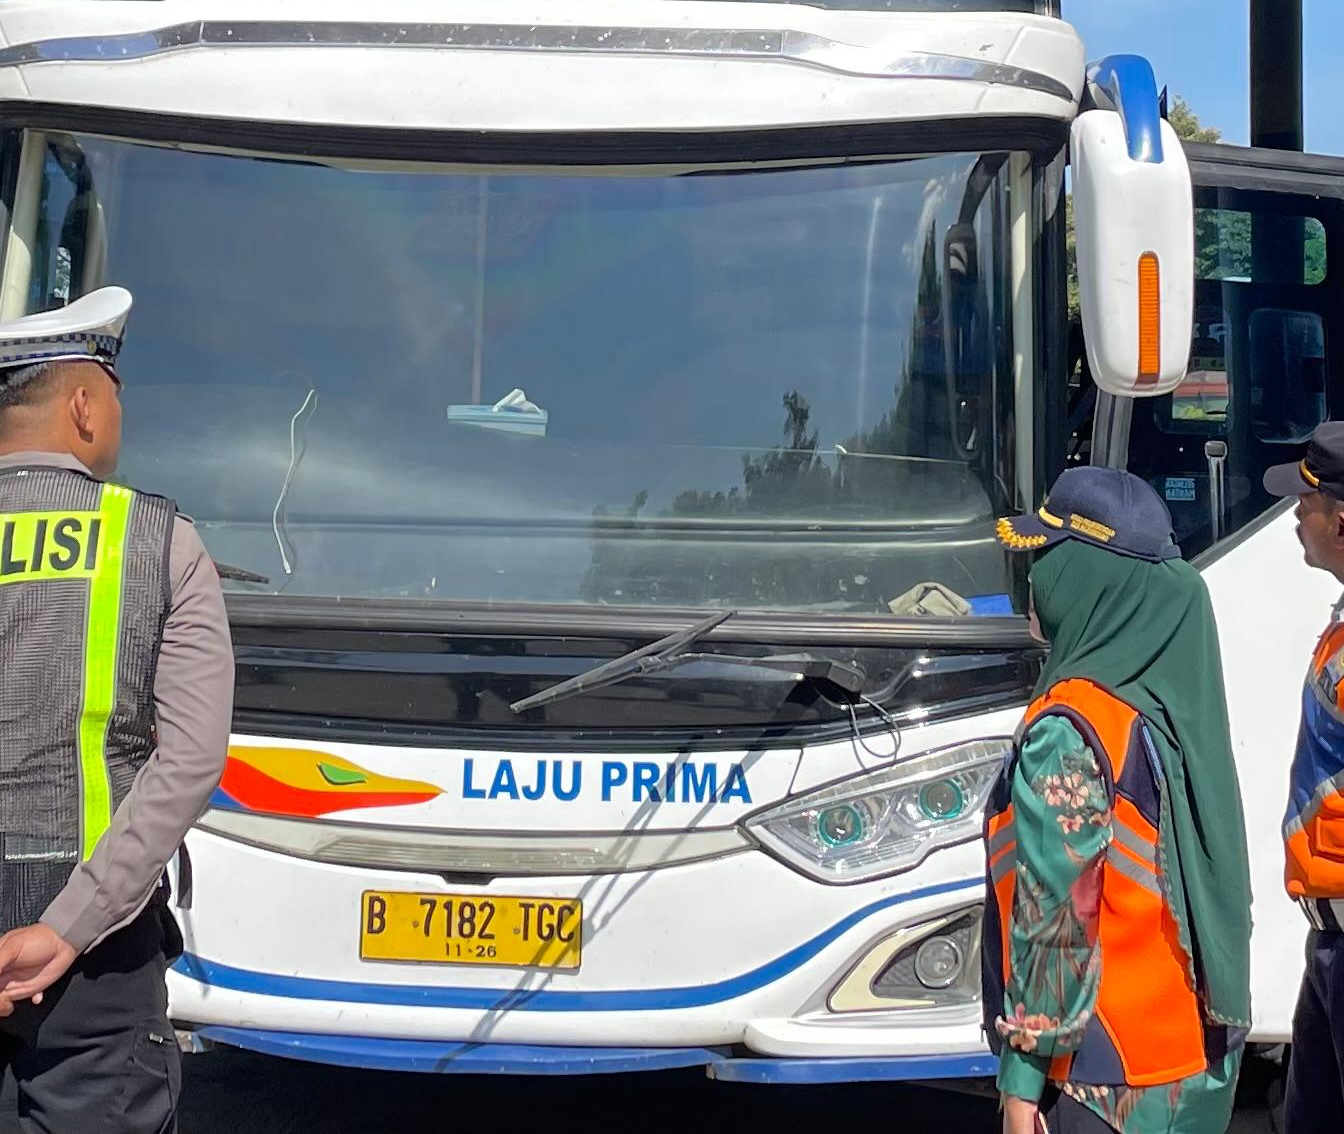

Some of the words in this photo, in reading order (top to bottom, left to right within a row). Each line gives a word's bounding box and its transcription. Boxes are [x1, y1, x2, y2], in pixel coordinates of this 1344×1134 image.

[462, 758, 582, 801] LAJU
[601, 761, 753, 804] PRIMA
[367, 895, 386, 934] B
[420, 898, 496, 940] 7182
[519, 902, 575, 943] TGC
